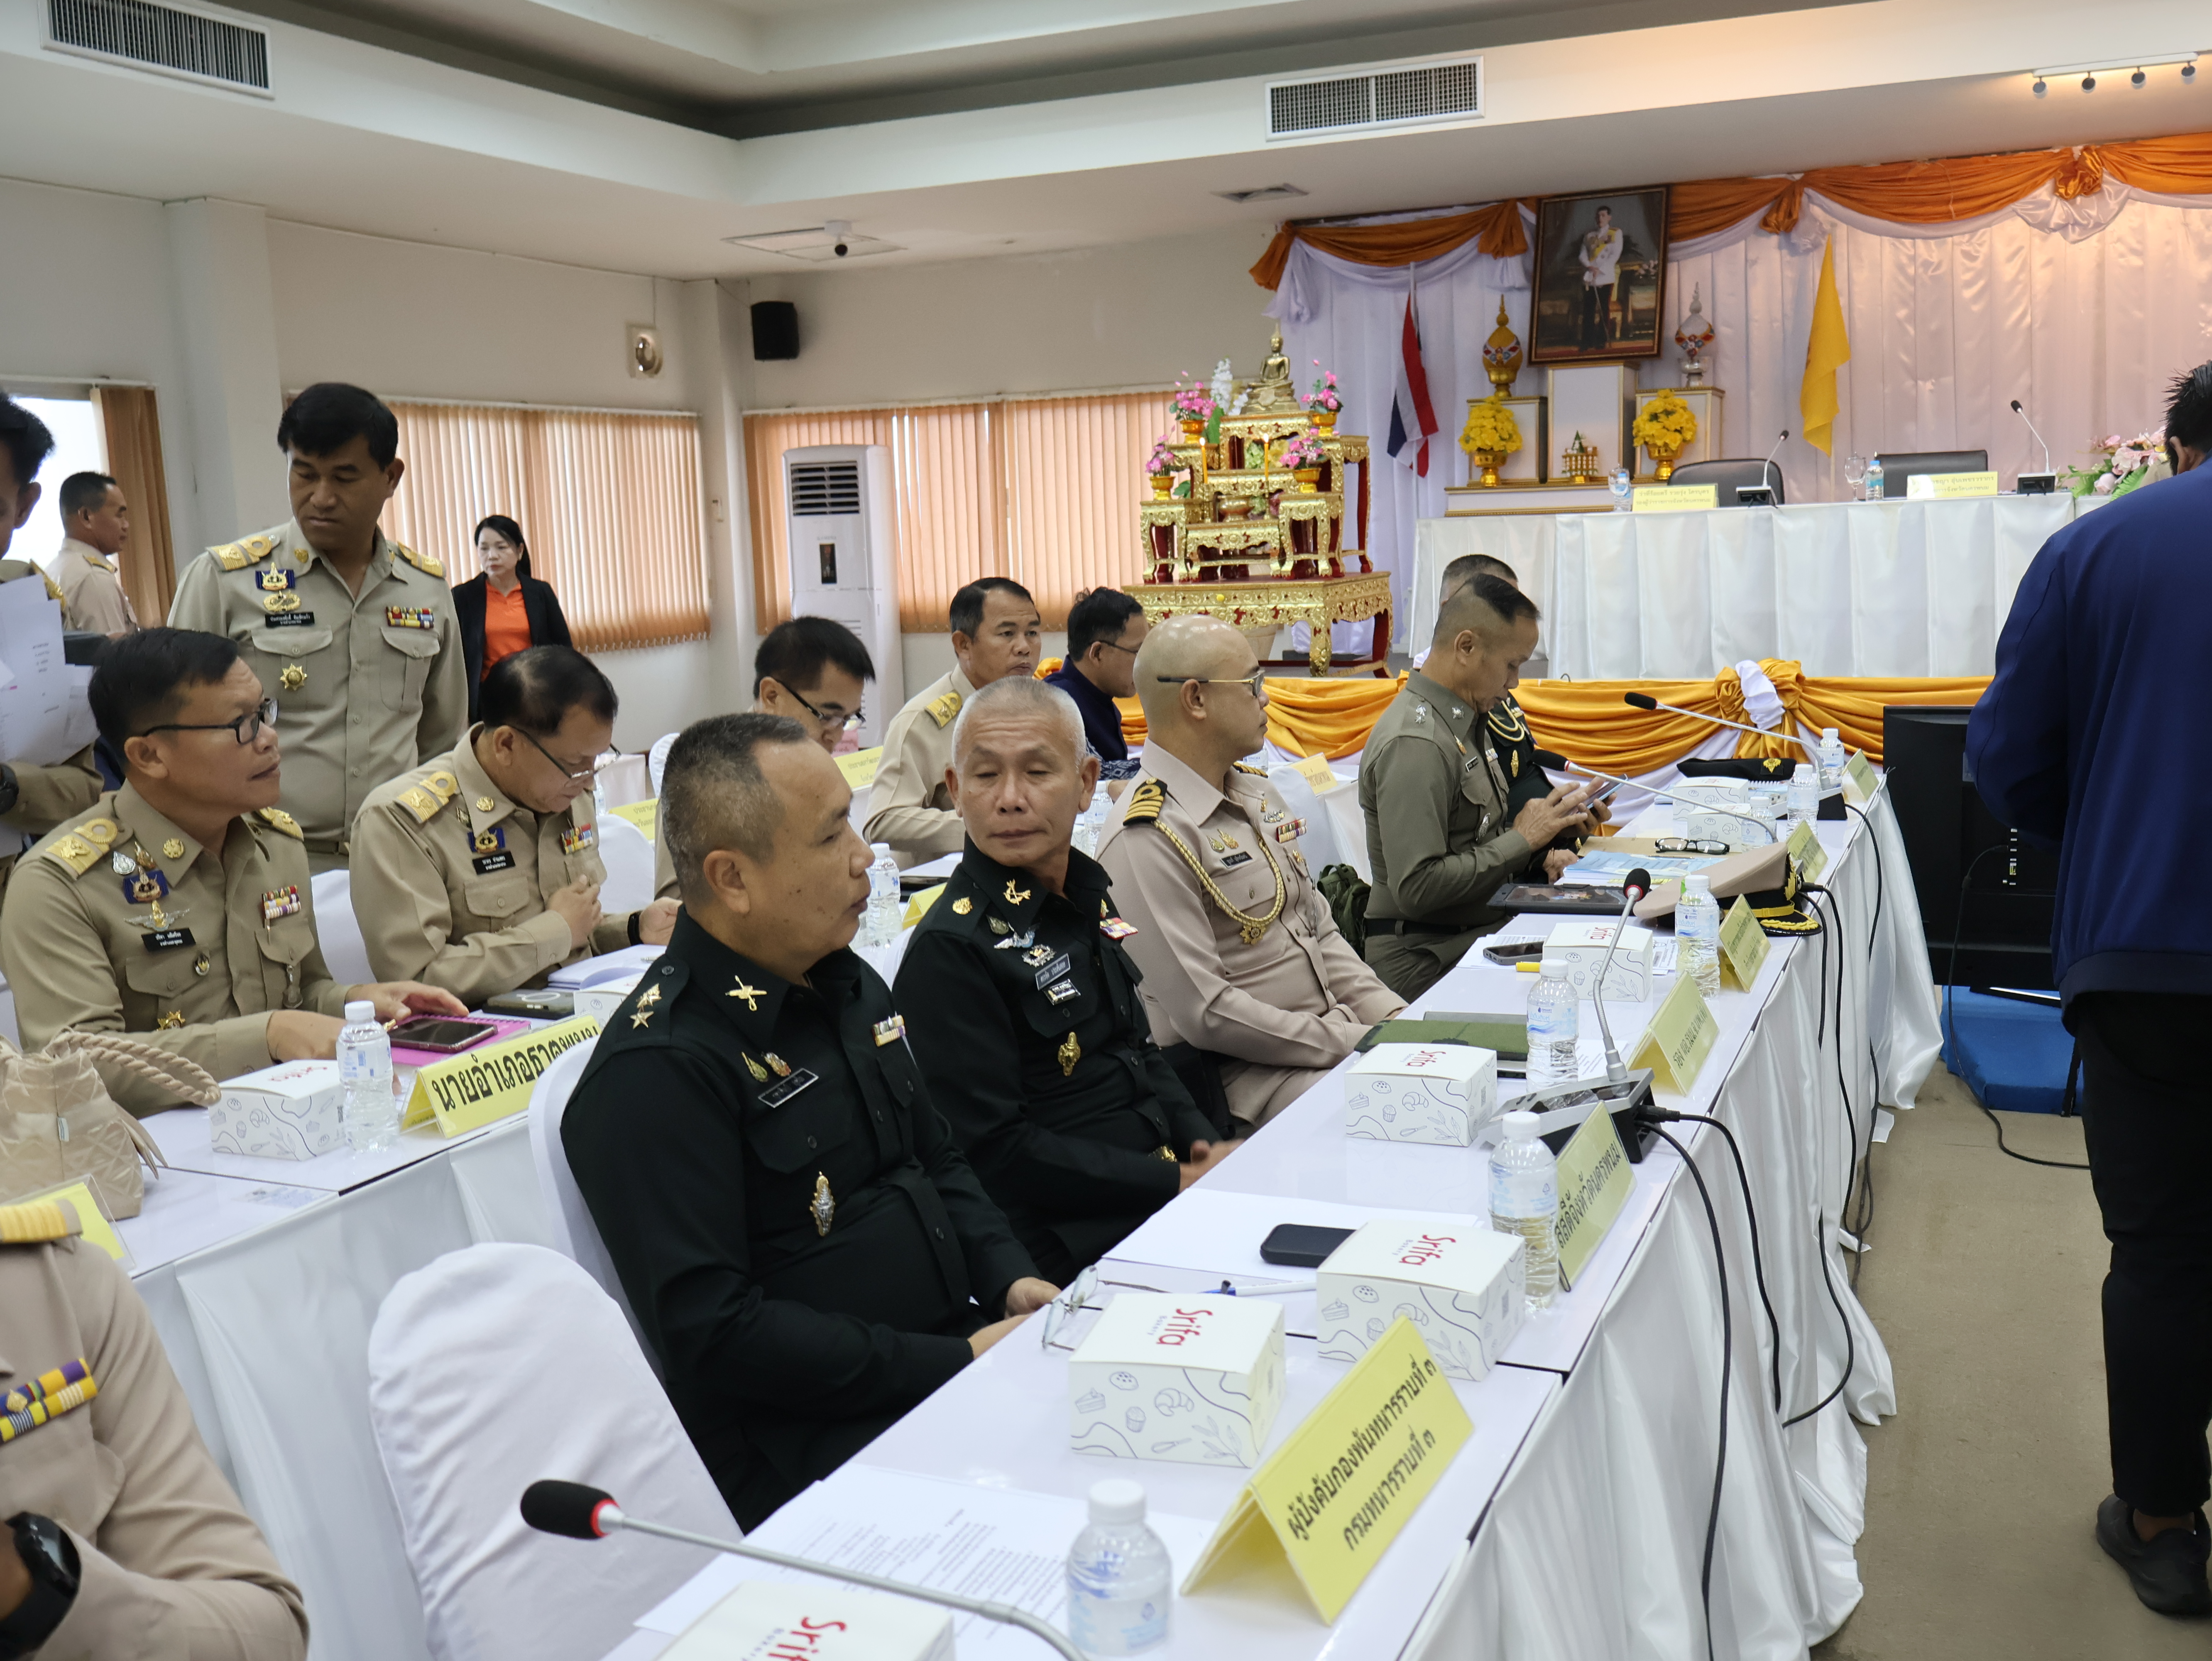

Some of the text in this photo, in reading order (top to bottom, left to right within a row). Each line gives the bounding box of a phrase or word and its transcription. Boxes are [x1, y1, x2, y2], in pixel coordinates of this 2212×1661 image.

[1590, 927, 1617, 940] Srifa
[431, 1025, 599, 1112] นายอำเภอธาต
[1405, 1051, 1446, 1067] Srifa
[1673, 1048, 1685, 1069] รอง
[1555, 1140, 1621, 1249] สสดีจังหวัดนครพนม
[1399, 1235, 1456, 1265] Srifa
[1156, 1308, 1213, 1345] Srifa
[1287, 1353, 1437, 1541] ผู้บังคับกองพันทหารราบที่ ๓
[1343, 1424, 1436, 1551] กรมทหารราบที่ ๓
[767, 1616, 847, 1661] Srif
